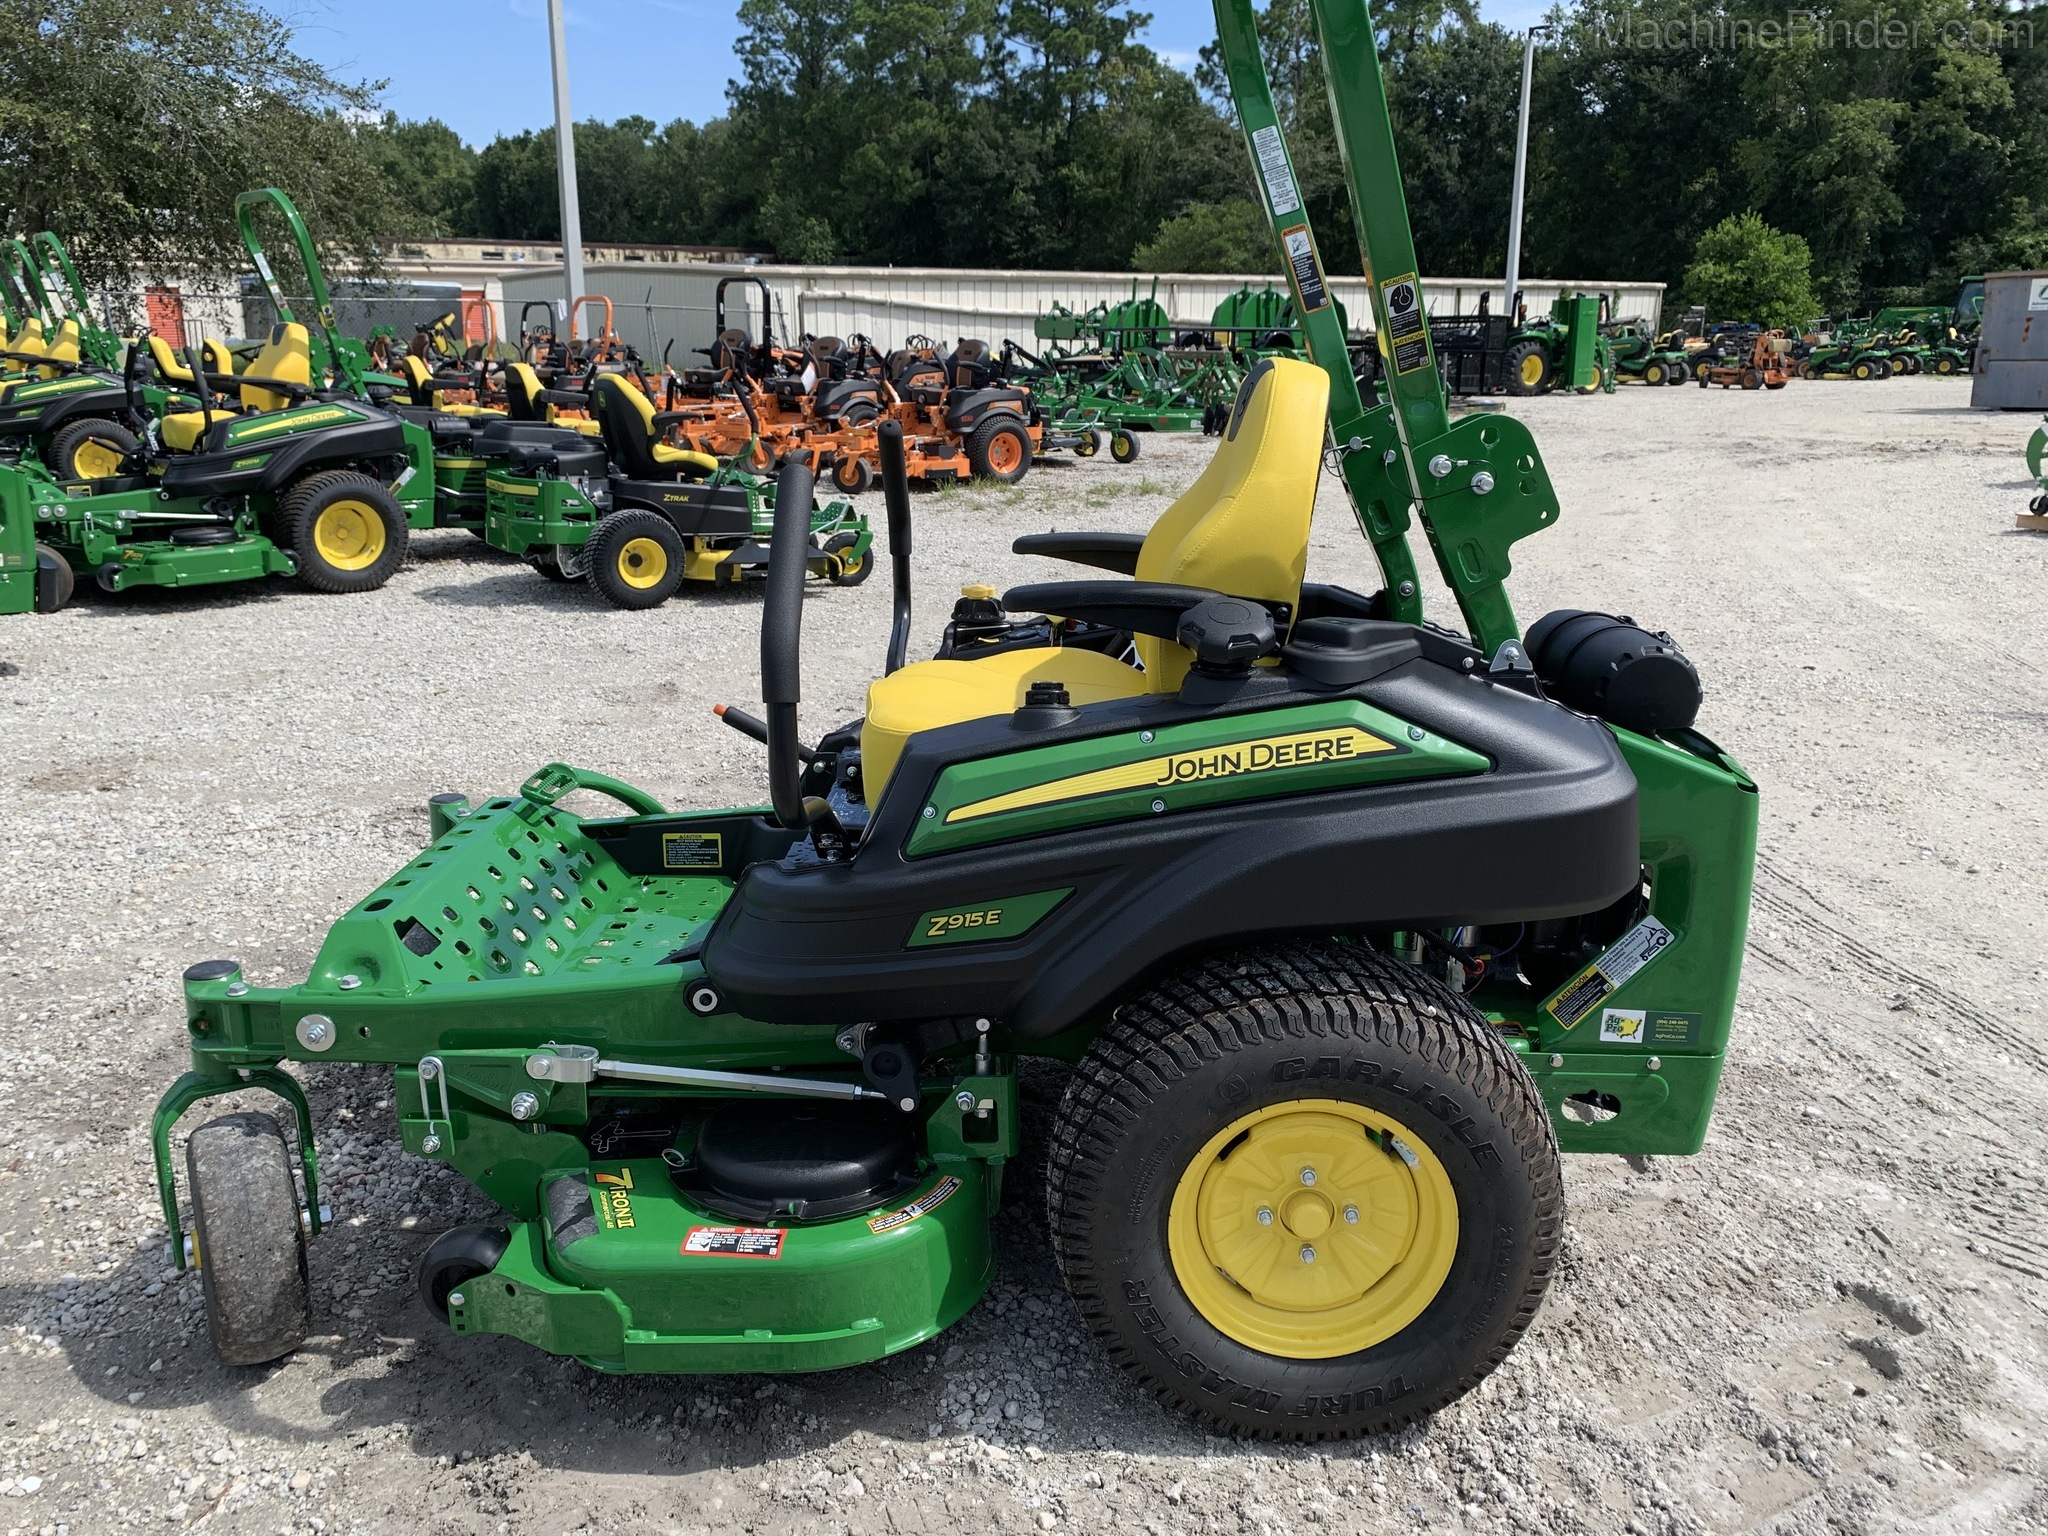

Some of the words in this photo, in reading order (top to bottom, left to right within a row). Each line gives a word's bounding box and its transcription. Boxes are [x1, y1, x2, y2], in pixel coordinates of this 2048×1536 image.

[1388, 274, 1412, 284] CAUTION
[1398, 331, 1425, 344] ATENCIÓN
[663, 494, 690, 502] ZTRAK
[1156, 751, 1243, 784] JOHN
[1250, 736, 1356, 769] DEERE
[926, 909, 1002, 937] Z915E
[1562, 974, 1588, 1000] ATENCIÓN
[1604, 1024, 1623, 1033] Pro
[1273, 1056, 1504, 1170] CARLISLE
[600, 1192, 612, 1221] Commercial
[1122, 1278, 1282, 1415] MASTER
[1287, 1374, 1418, 1418] TURF
